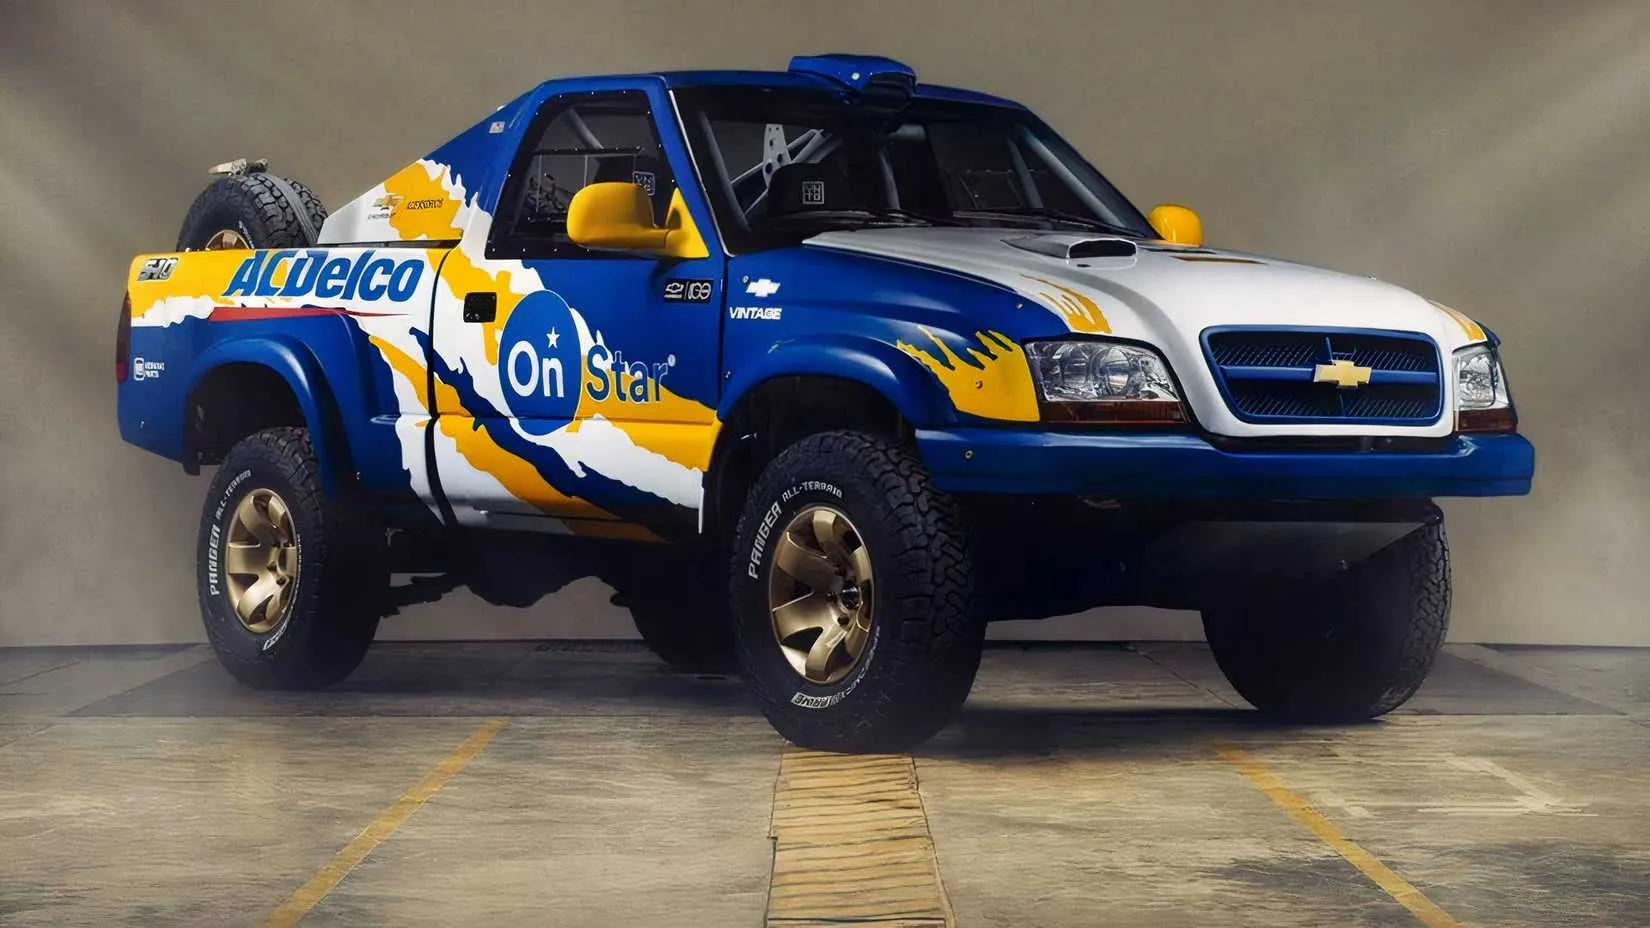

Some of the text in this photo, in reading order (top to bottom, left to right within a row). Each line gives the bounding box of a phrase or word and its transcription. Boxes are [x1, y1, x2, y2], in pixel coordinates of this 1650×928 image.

[221, 250, 425, 302] ACDelco
[729, 306, 783, 320] VINTAGE
[507, 340, 669, 405] On Star
